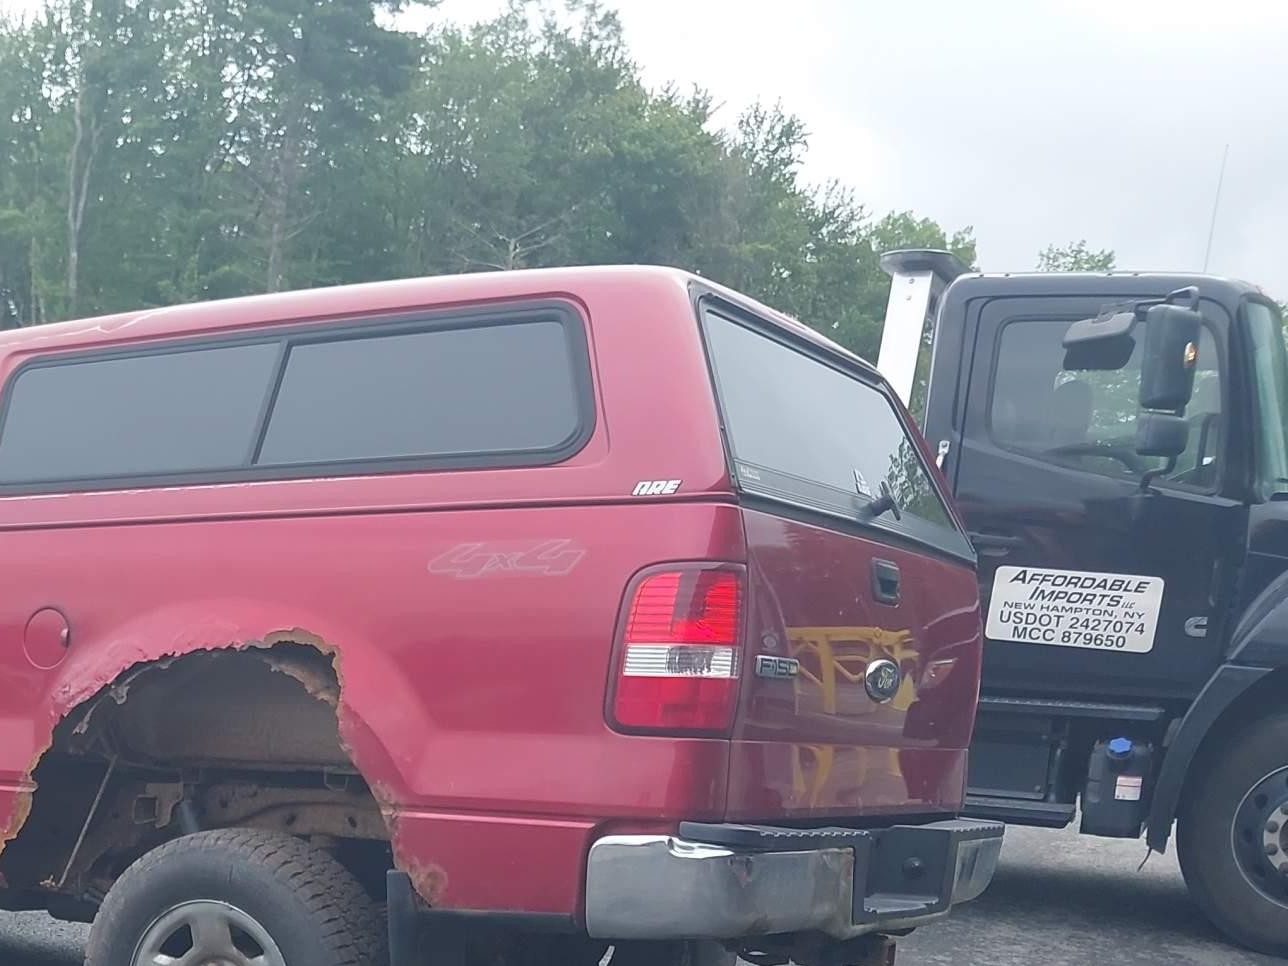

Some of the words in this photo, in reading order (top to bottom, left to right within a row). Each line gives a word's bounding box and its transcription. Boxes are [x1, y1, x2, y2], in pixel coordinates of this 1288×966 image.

[1009, 569, 1151, 593] AFFORDABLE
[1028, 586, 1124, 607] IMPORTS
[1003, 601, 1036, 610] NEW
[1040, 604, 1118, 619] HAMPTON,
[1123, 611, 1146, 619] NY
[999, 610, 1065, 628] USDOT
[1068, 616, 1146, 635] 2427074
[1012, 626, 1056, 642] MCC
[1061, 630, 1127, 648] 879650
